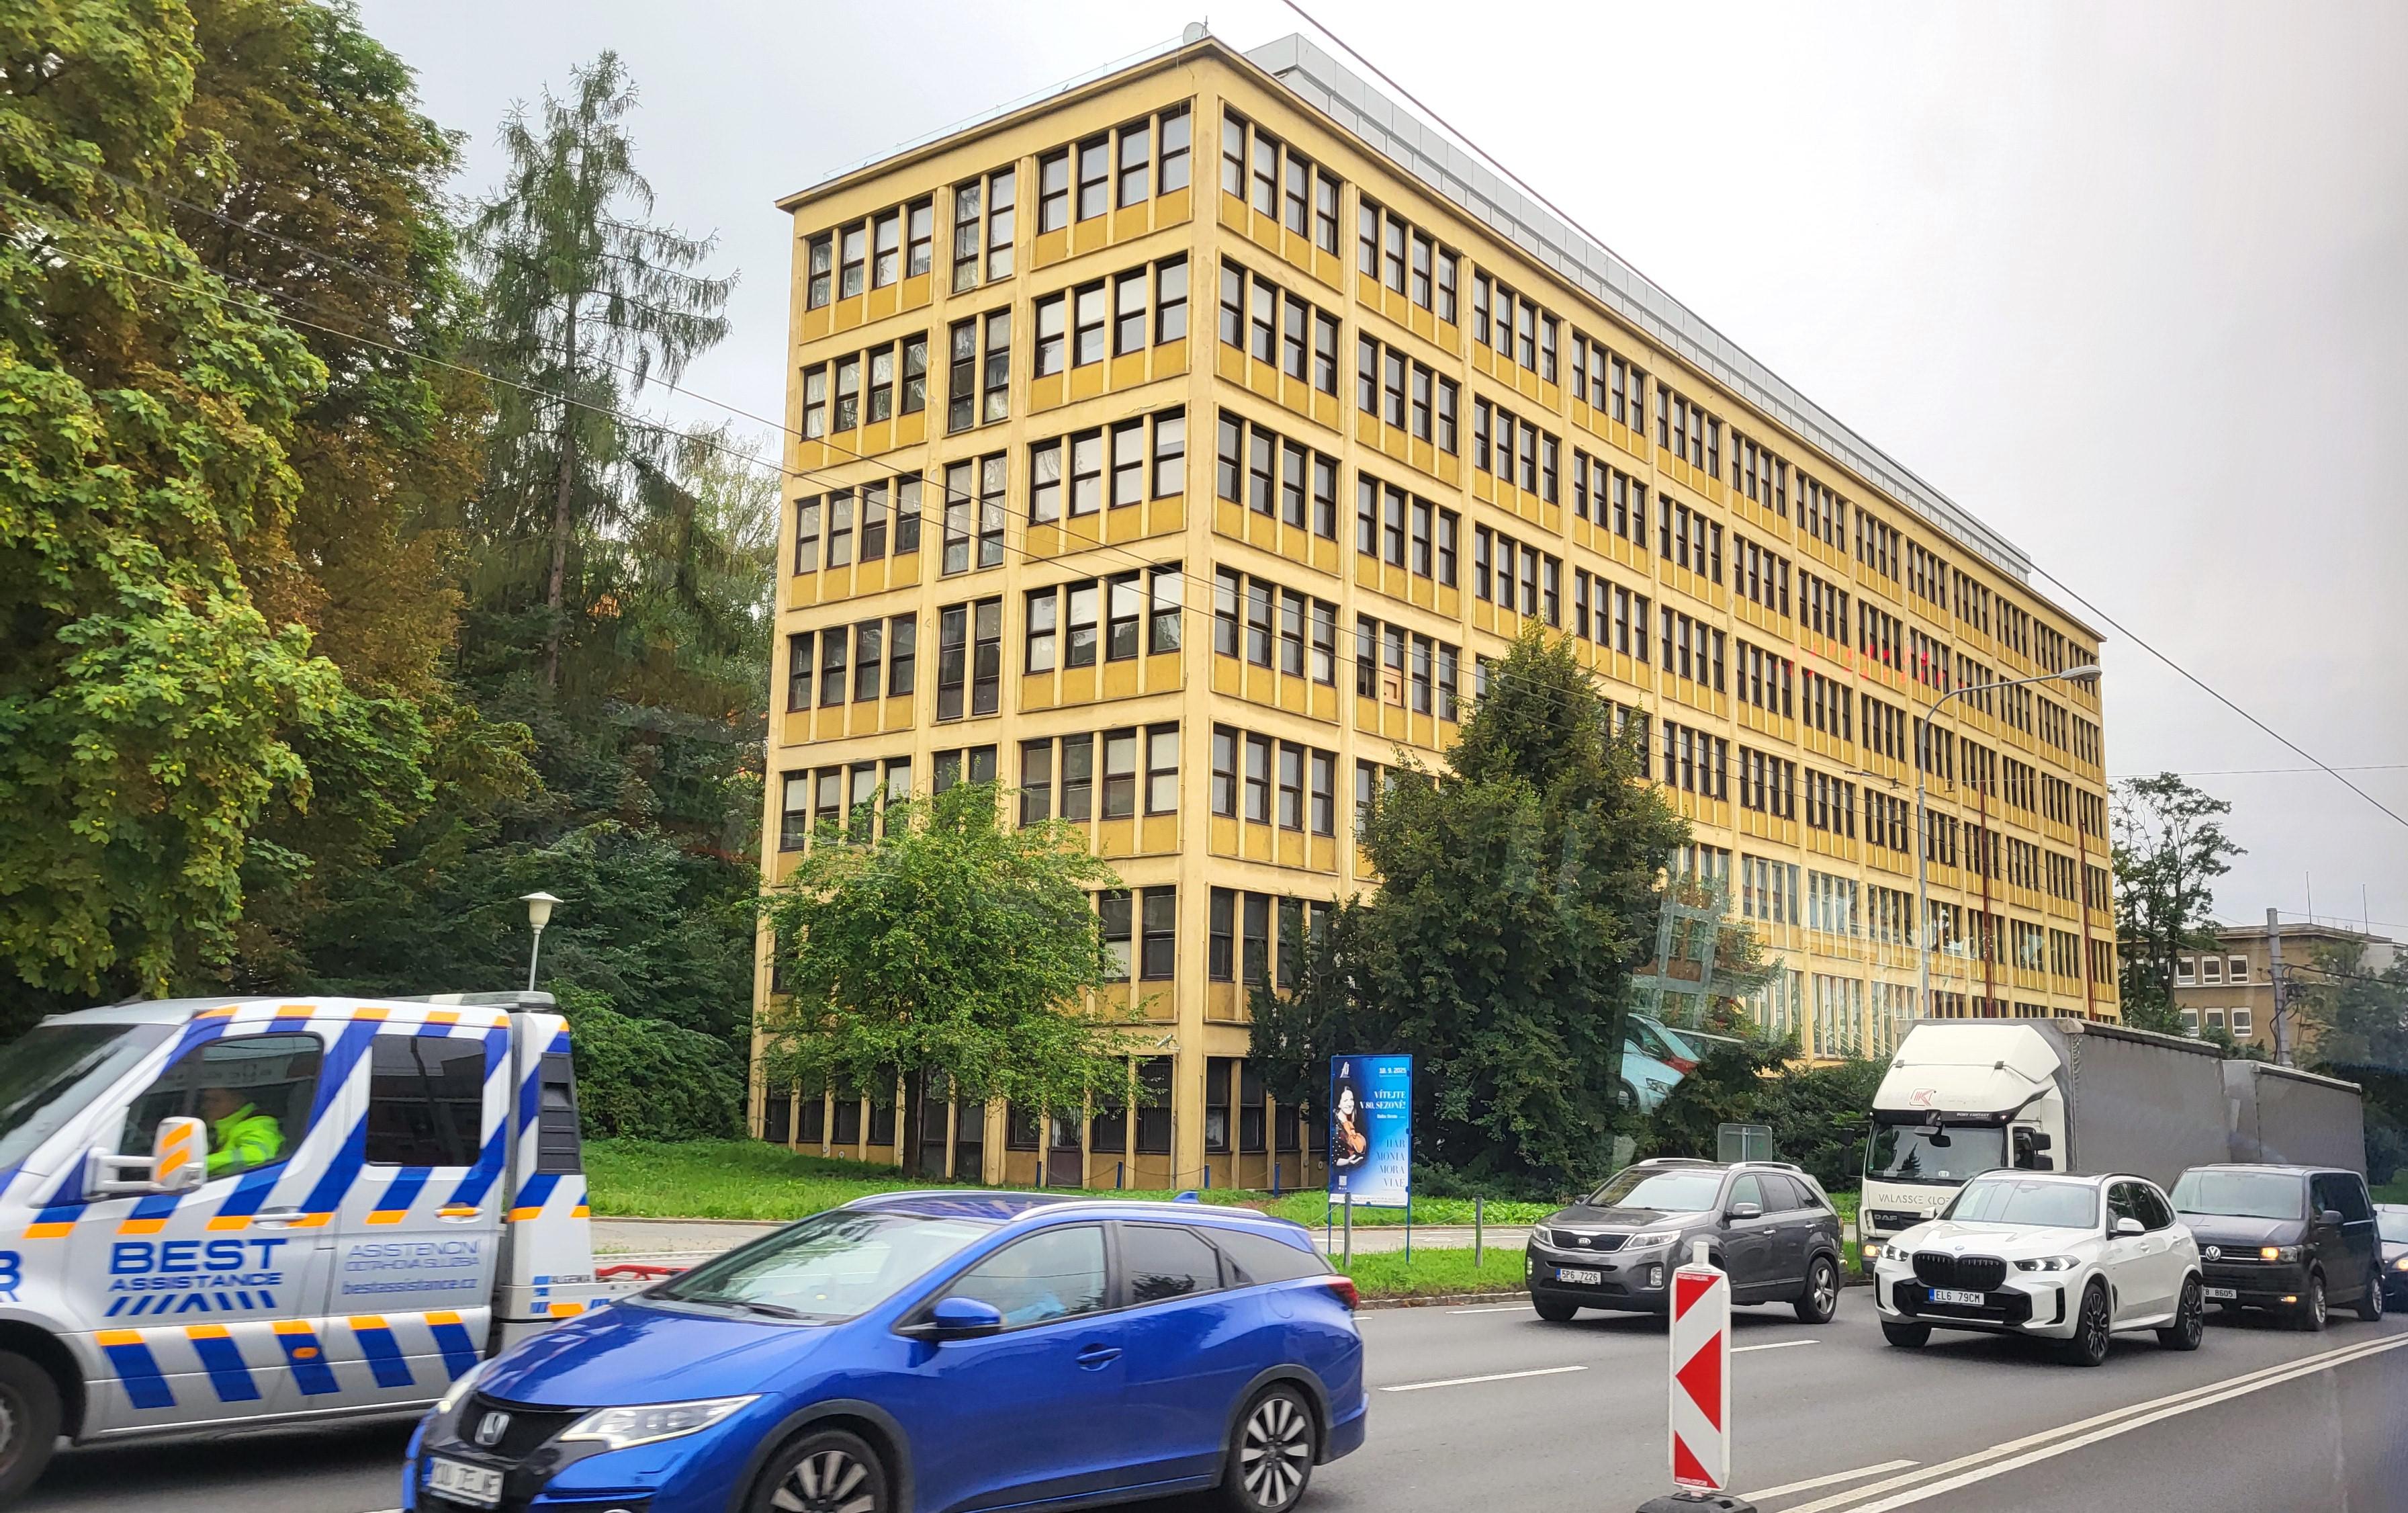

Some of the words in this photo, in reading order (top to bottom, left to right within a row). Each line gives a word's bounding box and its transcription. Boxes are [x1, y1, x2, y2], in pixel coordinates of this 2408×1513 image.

[1374, 1089, 1407, 1099] VÍTEJTE
[1359, 1101, 1365, 1109] V
[1386, 1139, 1405, 1148] HAR
[1376, 1151, 1405, 1162] MONIA
[1380, 1164, 1405, 1174] MORA
[1384, 1177, 1404, 1187] VIAE
[109, 1238, 289, 1275] BEST
[1562, 1270, 1575, 1279] 5P6
[1579, 1271, 1598, 1281] 7226
[107, 1271, 284, 1293] ASSISTANCE
[1936, 1290, 1952, 1301] EL6
[1958, 1292, 1980, 1303] 79CM
[2215, 1289, 2233, 1297] 8605
